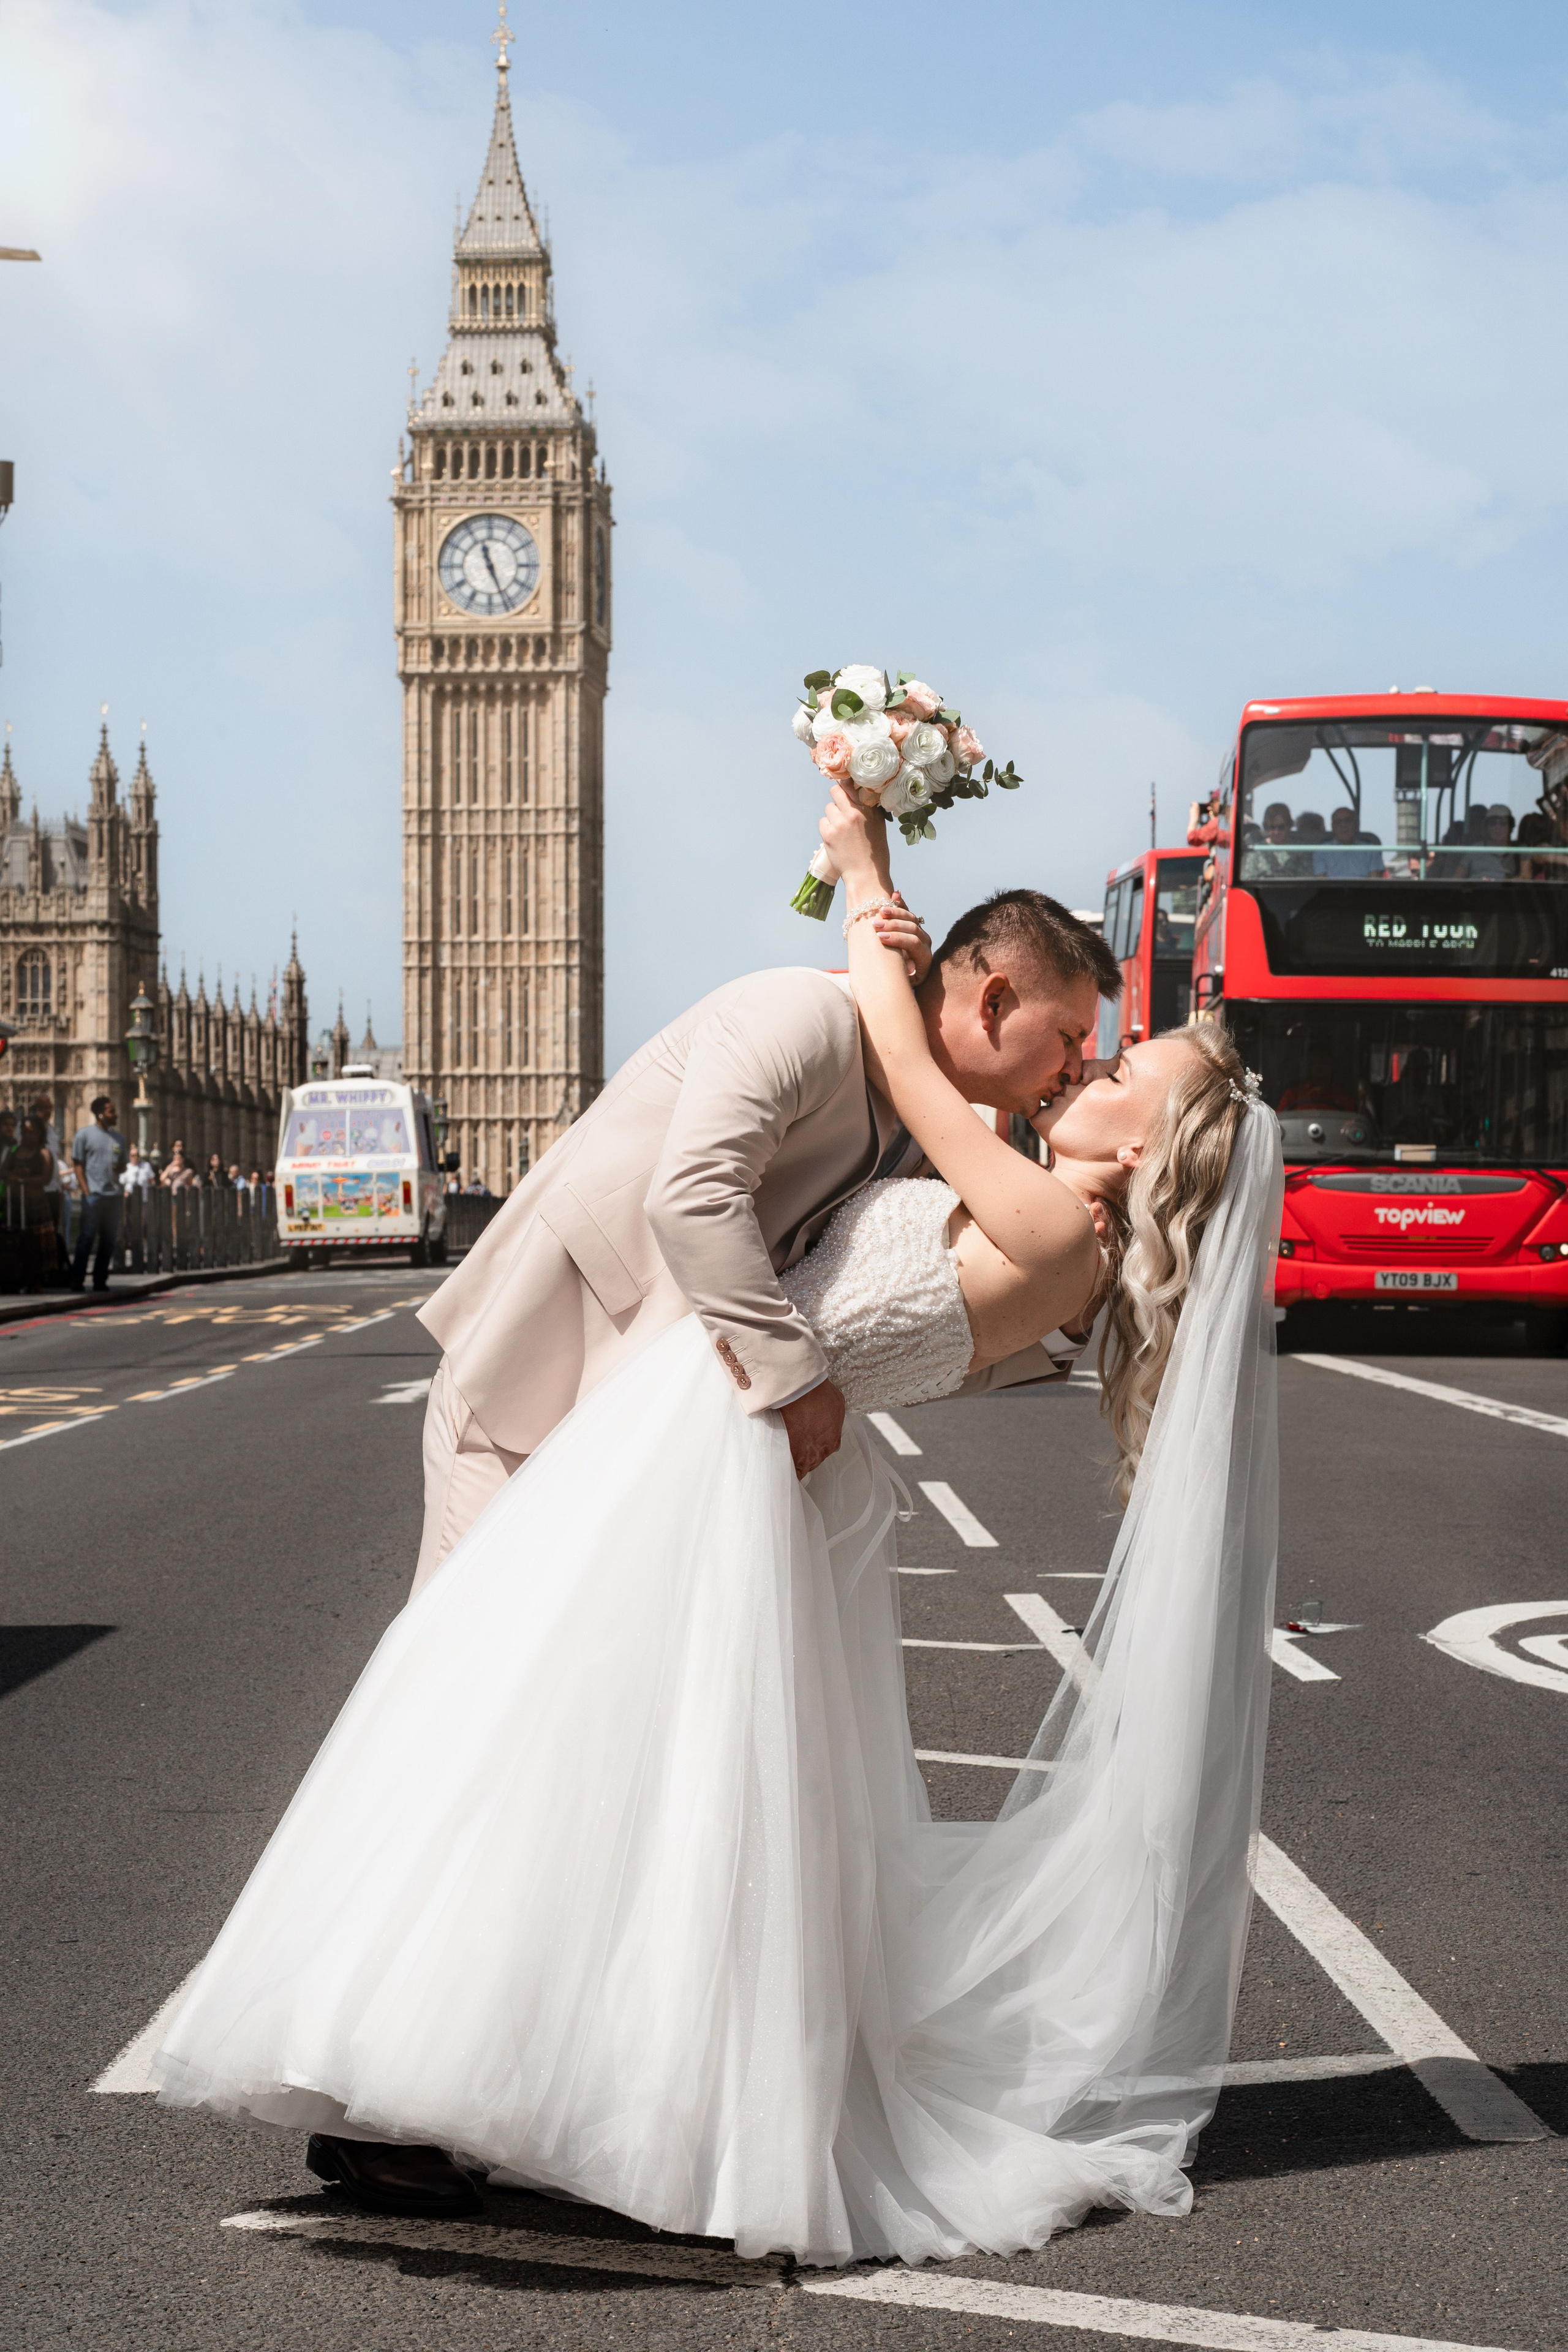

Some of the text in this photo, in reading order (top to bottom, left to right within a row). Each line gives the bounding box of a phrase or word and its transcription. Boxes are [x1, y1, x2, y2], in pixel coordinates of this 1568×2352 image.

[1364, 914, 1407, 938] RED
[336, 1090, 387, 1103] WHIPPY
[1370, 1174, 1462, 1193] SCANIA
[1381, 1273, 1452, 1287] YT09 BJX
